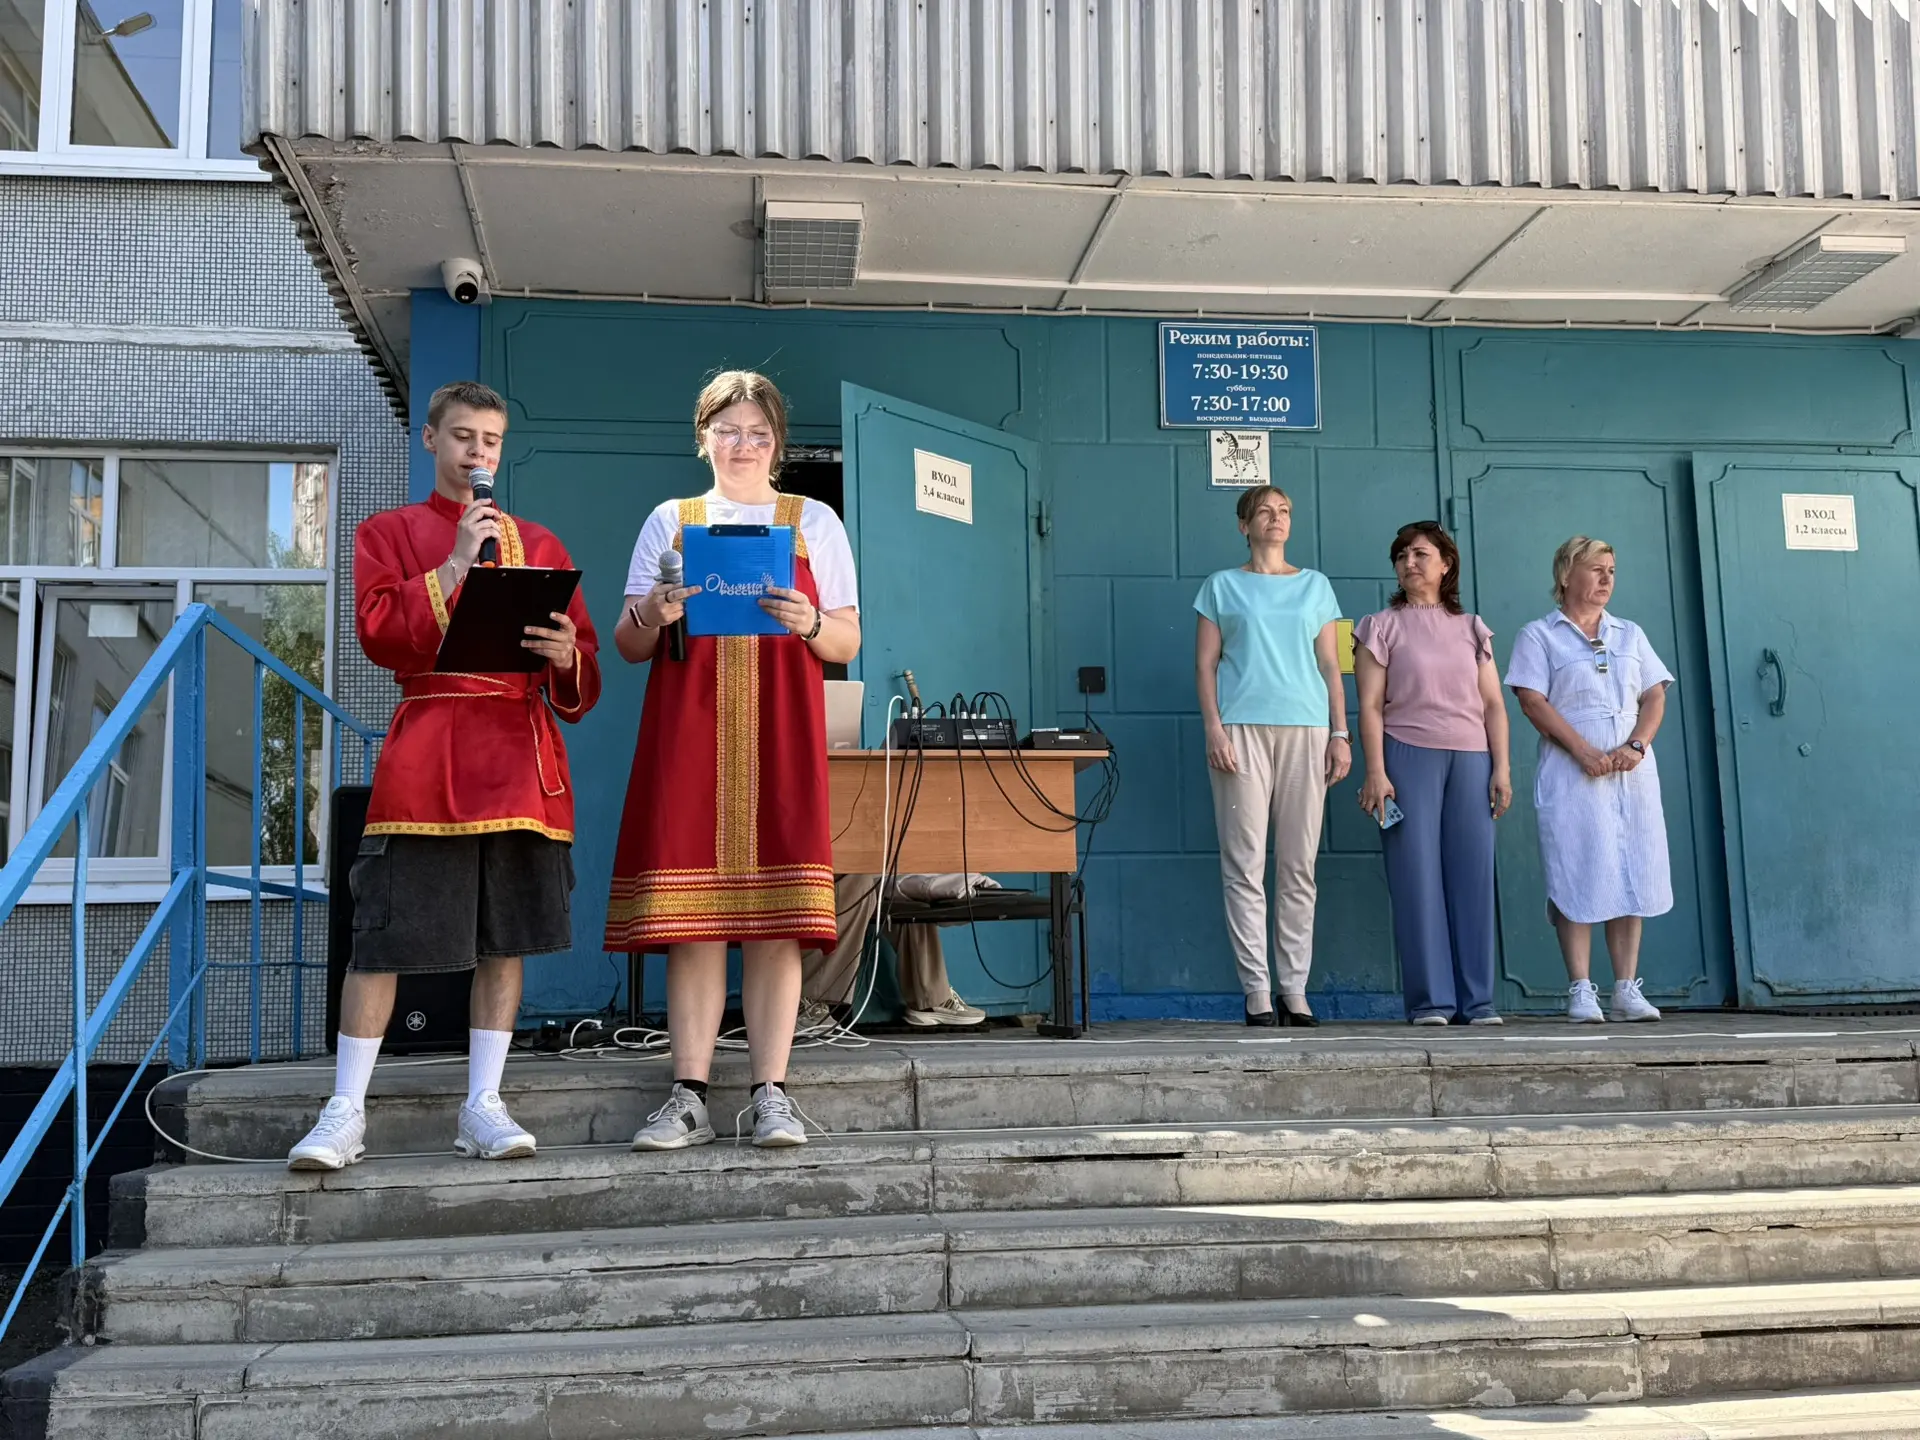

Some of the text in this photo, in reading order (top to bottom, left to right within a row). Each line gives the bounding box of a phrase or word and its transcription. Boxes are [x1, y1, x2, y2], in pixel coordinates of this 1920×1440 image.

[1169, 329, 1310, 349] Режим работы:
[1197, 352, 1282, 360] понедельник-пятница
[1192, 363, 1289, 380] 7:30-19:30
[1226, 384, 1256, 392] суббота
[1191, 395, 1290, 412] 7:30-17:00
[1196, 415, 1244, 423] воскресенье
[931, 470, 957, 488] ВХОД
[923, 485, 965, 506] 3,4 классы
[1804, 509, 1836, 520] ВХОД
[1795, 524, 1847, 535] 1,2 классы
